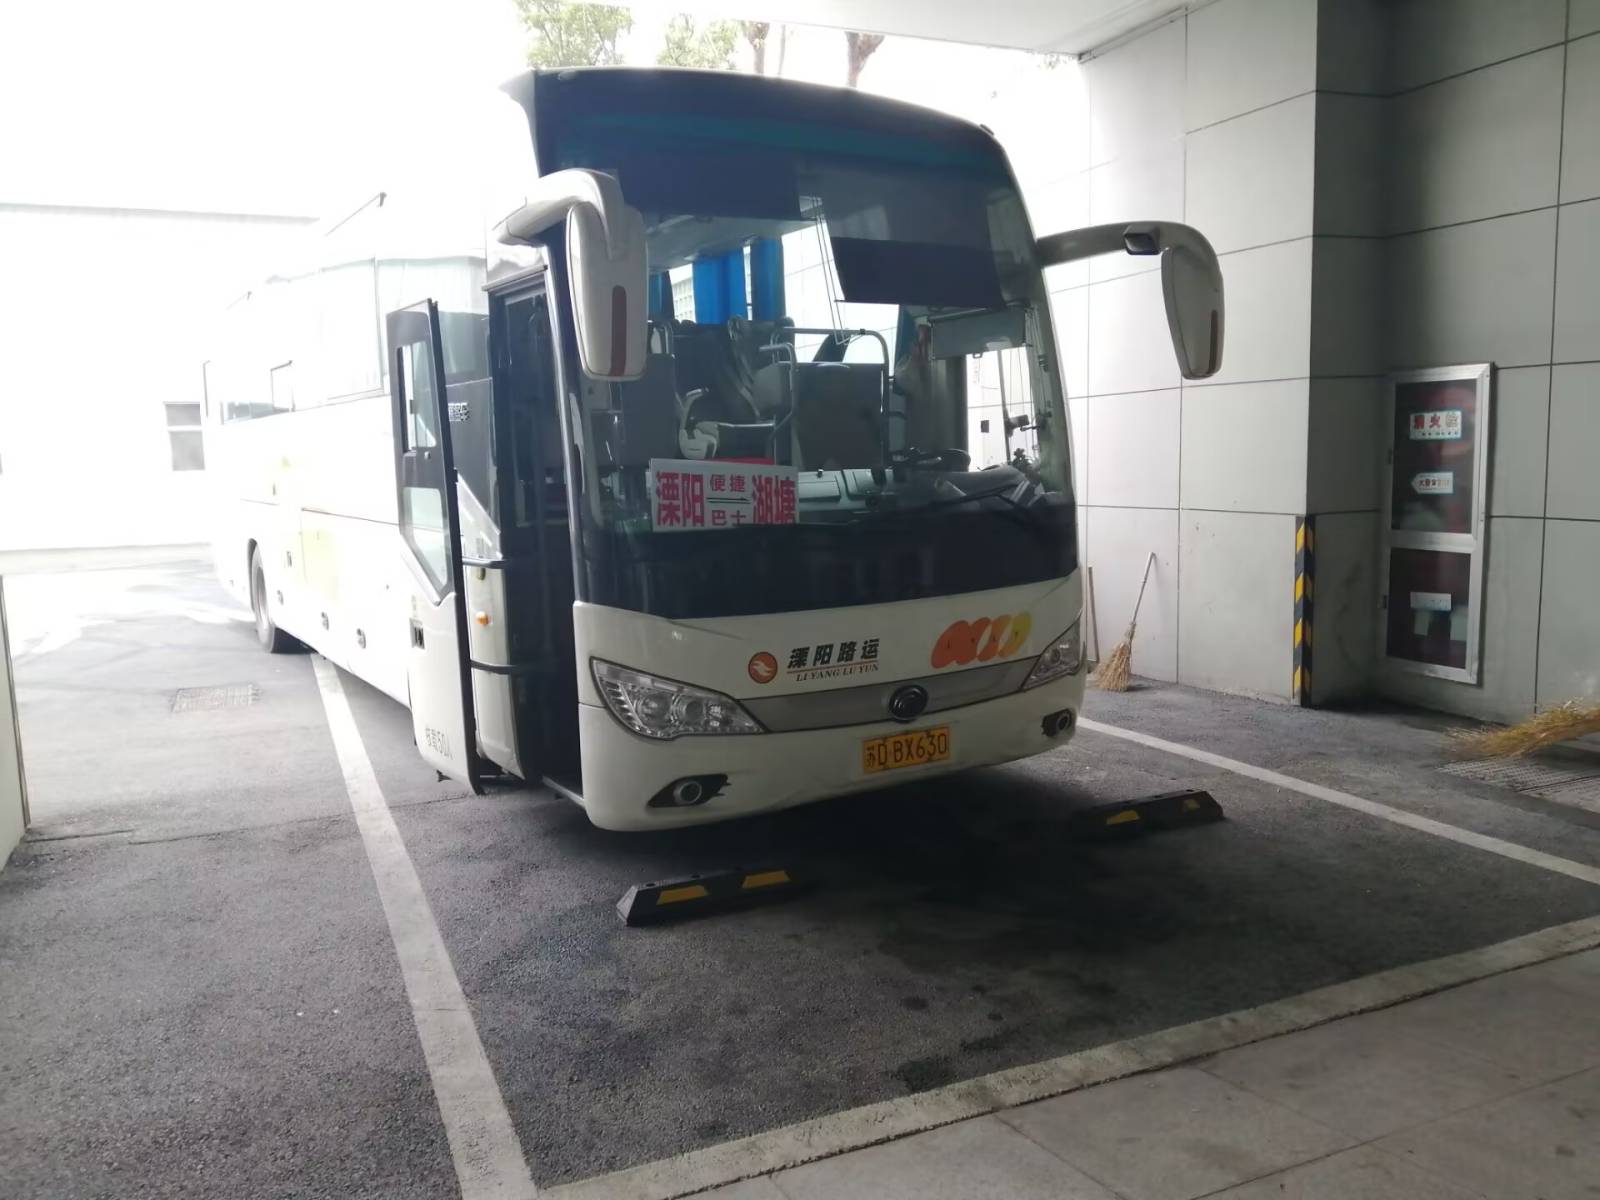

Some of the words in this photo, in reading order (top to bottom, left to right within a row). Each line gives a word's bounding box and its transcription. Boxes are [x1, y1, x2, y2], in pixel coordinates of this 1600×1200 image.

[710, 474, 745, 492] 便捷
[656, 472, 704, 526] 溧阳
[712, 510, 746, 526] 巴士
[787, 638, 880, 669] 溧阳路运
